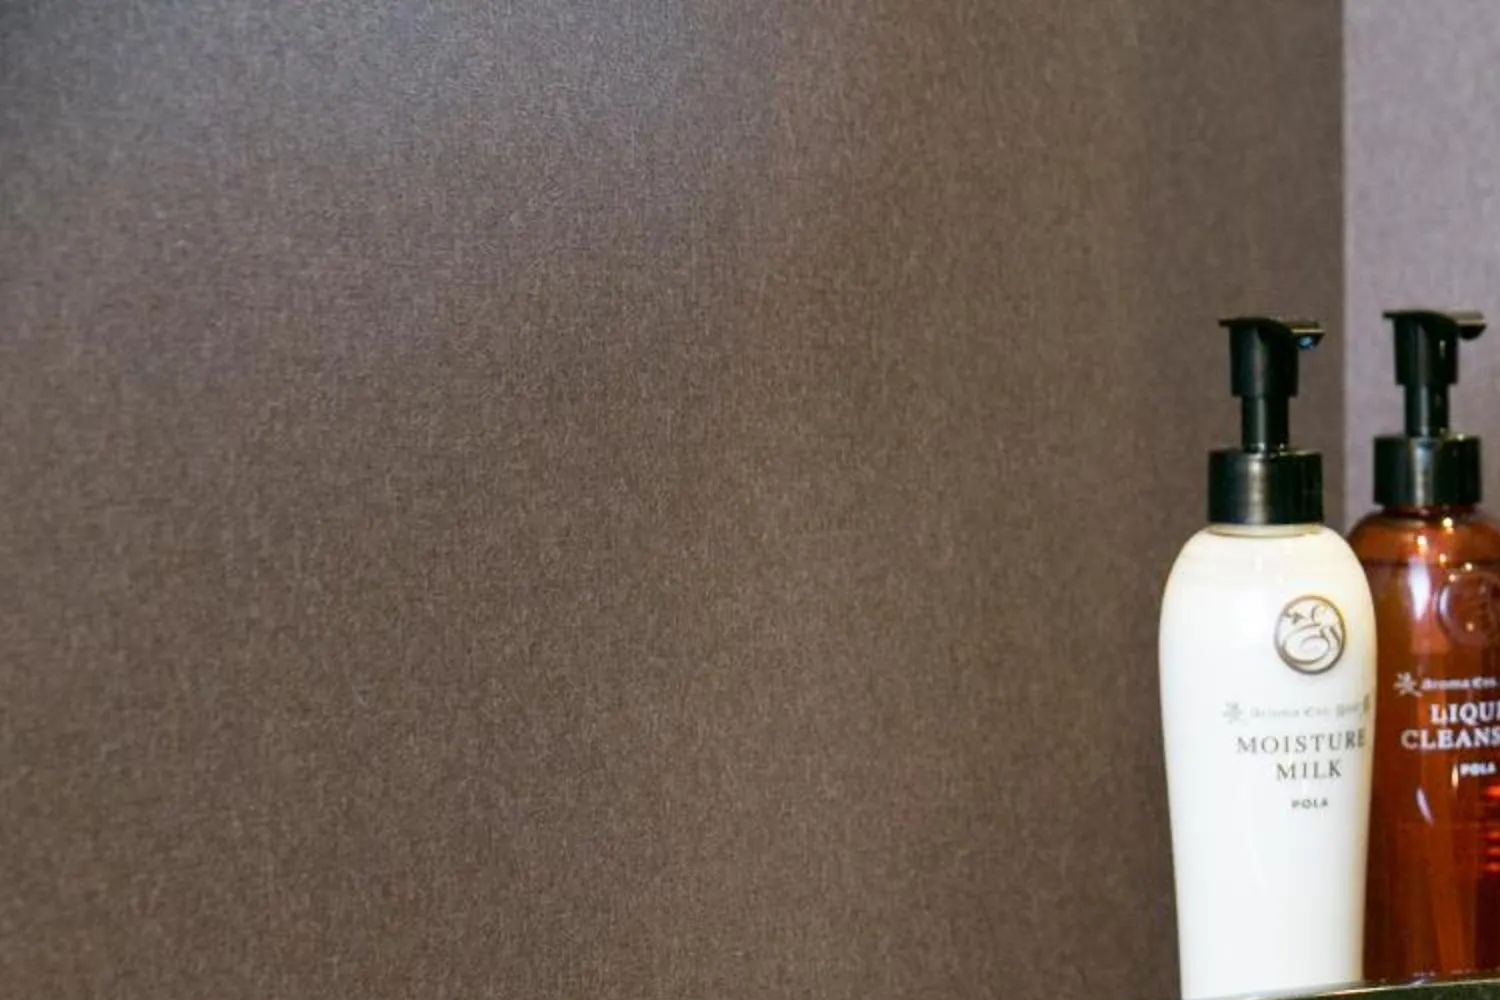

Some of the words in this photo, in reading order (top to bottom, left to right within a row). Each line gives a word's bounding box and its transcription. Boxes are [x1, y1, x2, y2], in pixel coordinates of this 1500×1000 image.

[1236, 728, 1367, 754] MOISTURE
[1276, 758, 1341, 781] MILK
[1291, 797, 1329, 810] POLA
